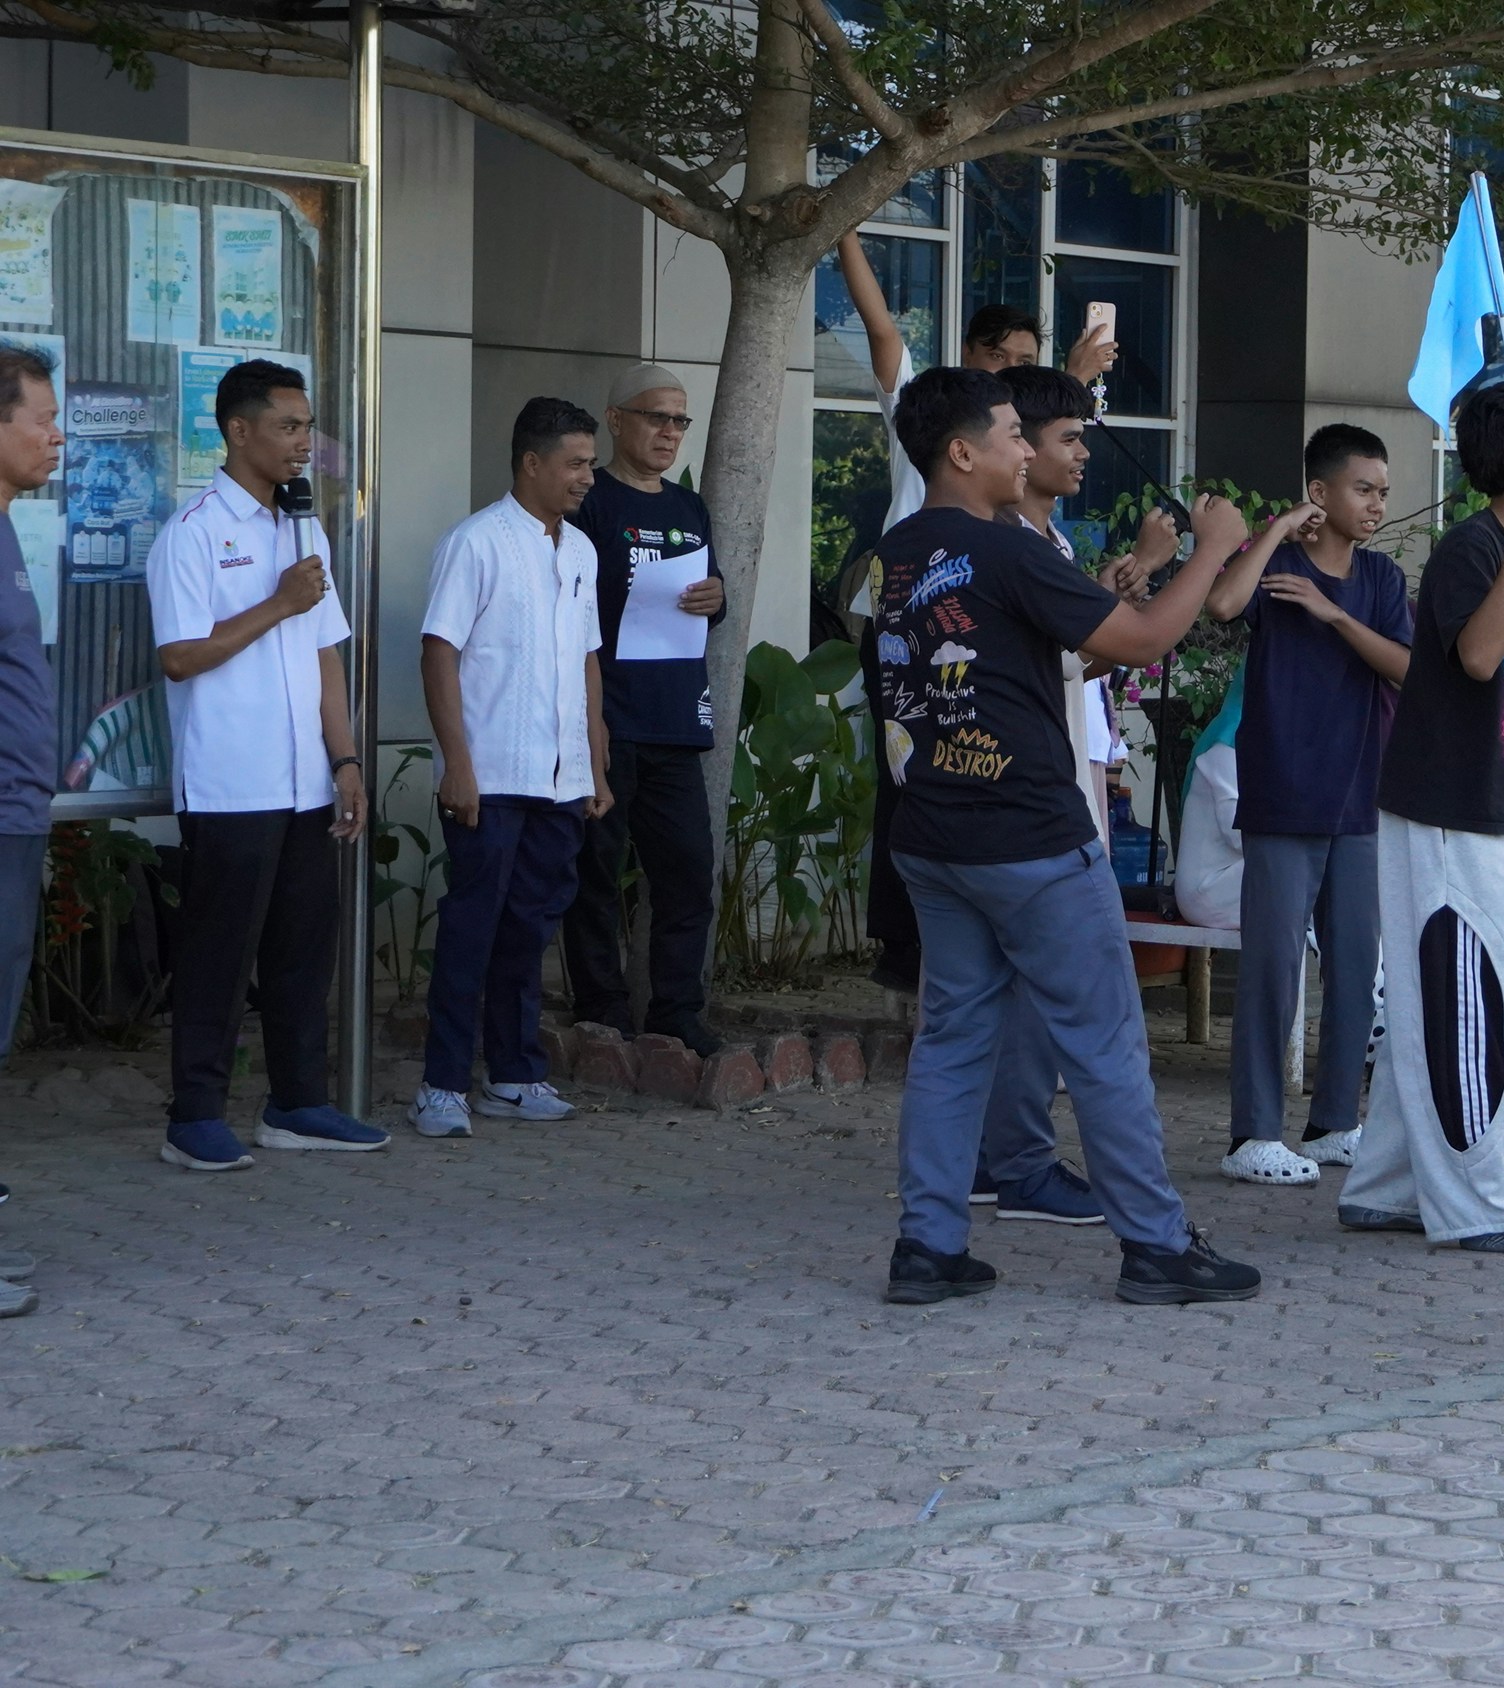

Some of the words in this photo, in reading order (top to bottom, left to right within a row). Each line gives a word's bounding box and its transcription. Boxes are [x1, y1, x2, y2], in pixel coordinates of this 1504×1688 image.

[72, 408, 146, 424] Challenge
[629, 546, 662, 564] SMTI
[911, 554, 973, 612] MADNESS
[933, 604, 956, 634] DRUNK
[942, 596, 979, 634] HUSTLE
[925, 682, 975, 699] Productive
[937, 706, 976, 725] Bullshit
[932, 739, 1013, 781] DESTROY
